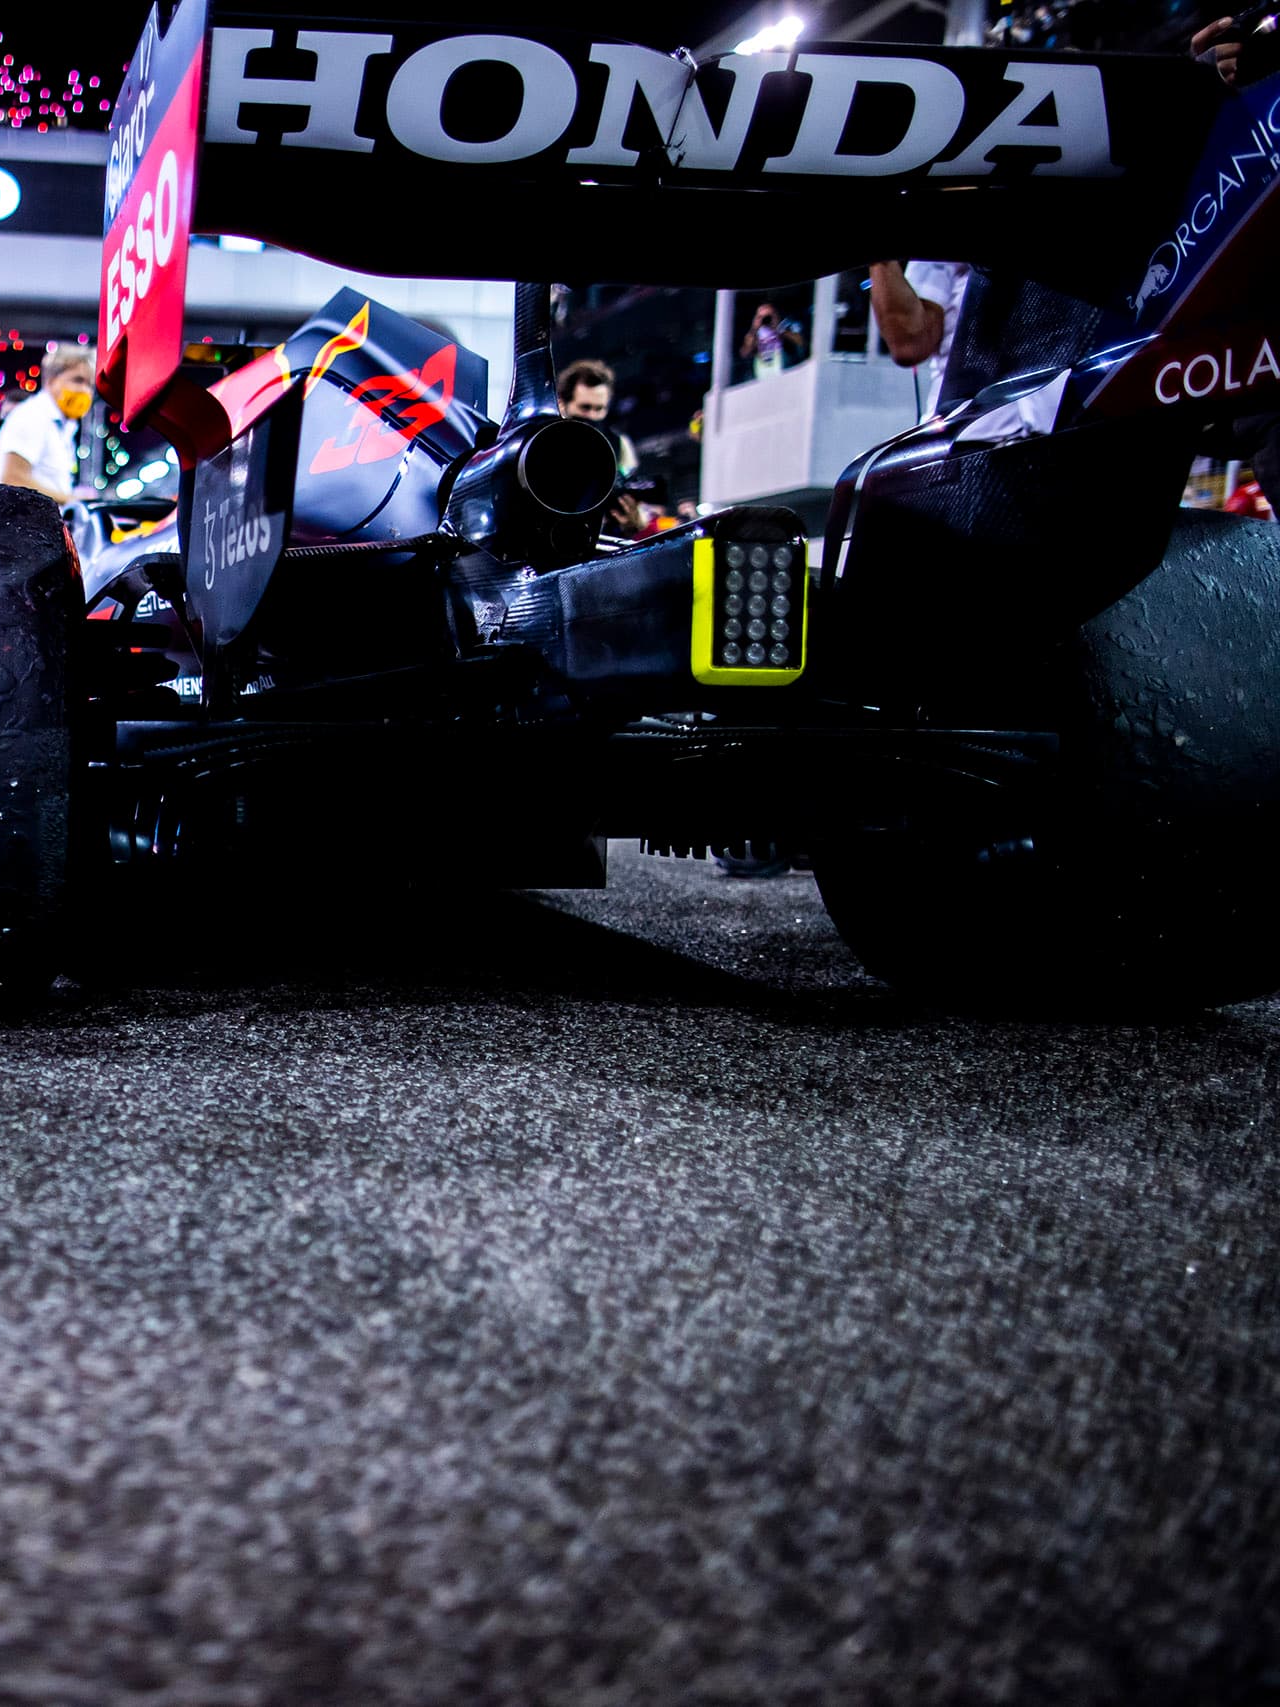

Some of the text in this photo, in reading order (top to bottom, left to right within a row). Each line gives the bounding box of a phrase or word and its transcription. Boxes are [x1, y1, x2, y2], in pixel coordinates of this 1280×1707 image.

[205, 26, 1124, 178] HONDA
[1154, 338, 1280, 404] COLA
[220, 492, 271, 570] Tezos
